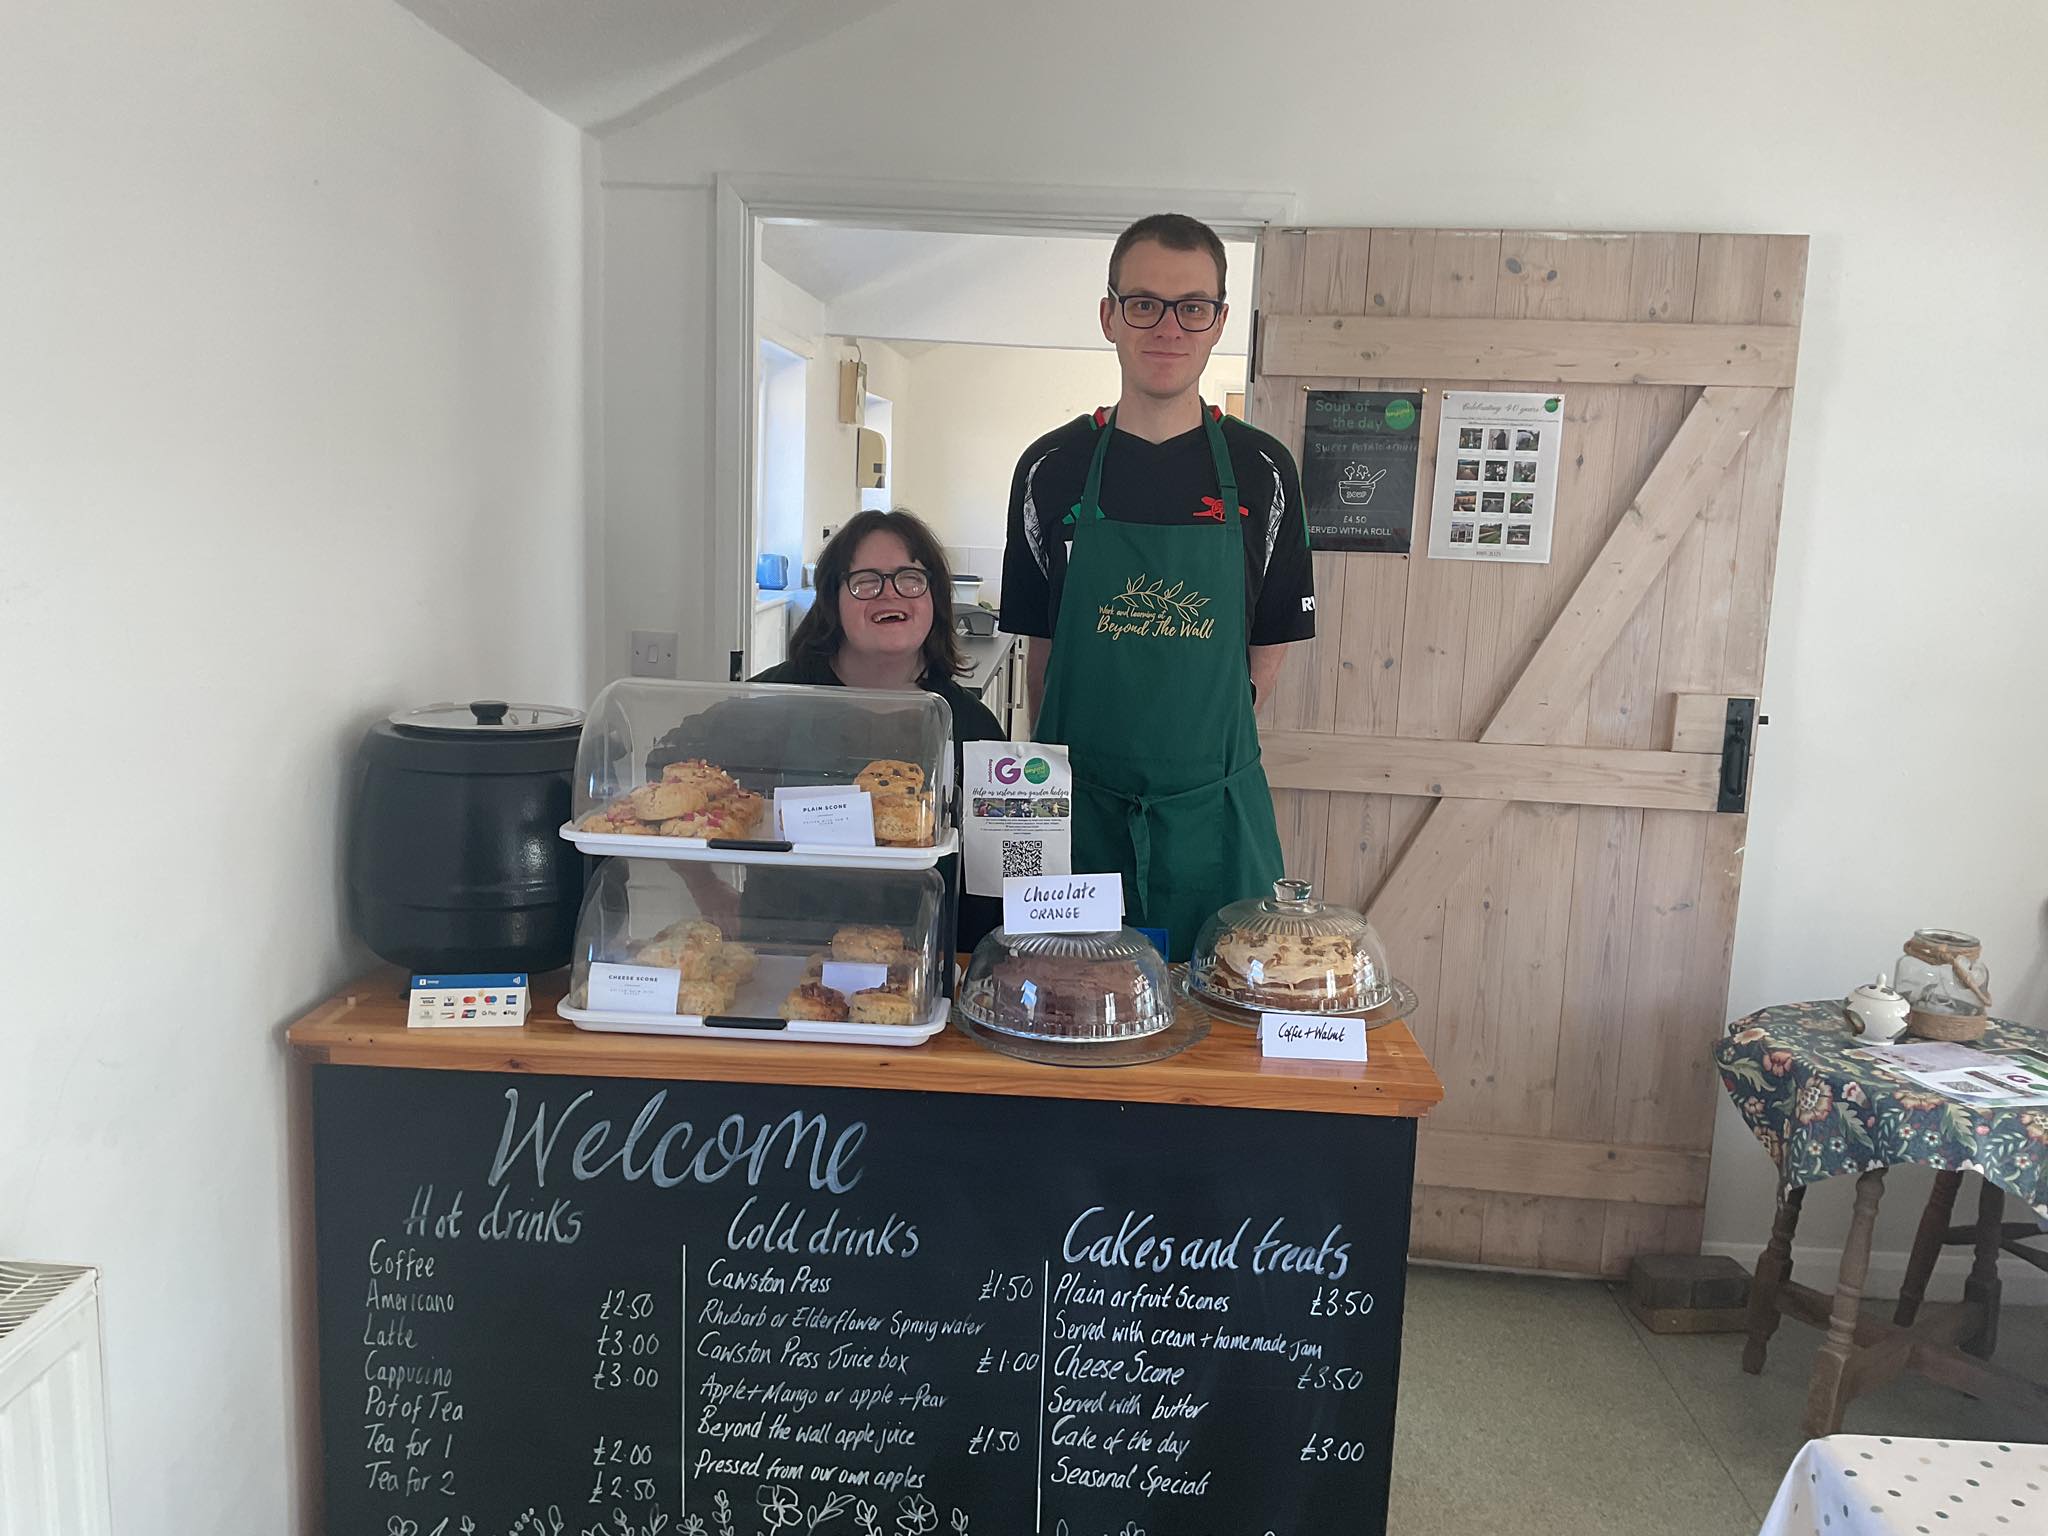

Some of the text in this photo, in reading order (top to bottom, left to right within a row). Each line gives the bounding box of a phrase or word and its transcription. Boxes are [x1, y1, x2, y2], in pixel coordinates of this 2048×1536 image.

[1315, 399, 1351, 415] Soup
[1355, 399, 1371, 413] of
[1333, 416, 1383, 433] the day
[1308, 526, 1391, 536] SERVED WITH A ROLL
[1096, 614, 1215, 641] Beyond The Wall
[824, 803, 847, 811] SCONE
[972, 787, 986, 797] Help
[1023, 882, 1096, 903] Chocolate
[1030, 907, 1080, 920] ORANGE
[488, 1088, 868, 1195] Welcome
[402, 1183, 584, 1244] Hot drinks
[727, 1195, 921, 1258] Cold drinks
[369, 1238, 436, 1281] Coffee
[1180, 1216, 1252, 1270] and
[1252, 1216, 1352, 1280] treats
[706, 1258, 832, 1294] Cawston Press
[978, 1269, 1034, 1301] £1.50
[1053, 1271, 1104, 1307] Plain
[1110, 1290, 1133, 1308] or
[1130, 1283, 1176, 1313] fruit
[366, 1278, 455, 1313] Americano
[600, 1289, 655, 1320] £2.50
[1309, 1285, 1375, 1317] £3.50
[363, 1312, 419, 1349] Latte
[698, 1298, 768, 1329] Rhubarb
[770, 1312, 788, 1329] or
[890, 1309, 939, 1342] Spring
[941, 1314, 987, 1337] water
[1053, 1309, 1107, 1341] Served
[1111, 1319, 1145, 1345] with
[1151, 1328, 1197, 1348] cream
[597, 1324, 660, 1356] £3.00
[696, 1330, 910, 1376] Cawston Press Juice box
[593, 1360, 659, 1390] £3.00
[976, 1347, 1041, 1374] £1.00
[1053, 1344, 1186, 1386] Cheese Scone
[1297, 1362, 1364, 1391] £3.50
[365, 1385, 464, 1424] Pot of Tea
[824, 1387, 845, 1404] or
[848, 1382, 895, 1412] apple
[1048, 1384, 1210, 1420] Served with butter
[364, 1423, 395, 1454] Tea
[405, 1427, 432, 1461] for
[697, 1403, 767, 1443] Beyond
[768, 1412, 791, 1440] the
[834, 1422, 876, 1452] apple
[874, 1420, 917, 1454] juice
[967, 1425, 1020, 1455] £1.50
[1051, 1414, 1191, 1462] Cake of the day
[592, 1436, 652, 1466] £2.00
[1300, 1432, 1366, 1463] £3.00
[365, 1460, 456, 1497] Tea for 2
[694, 1448, 926, 1489] Pressed from our own apples
[1051, 1455, 1212, 1498] Seasonal Specials
[588, 1470, 656, 1503] £2.50
